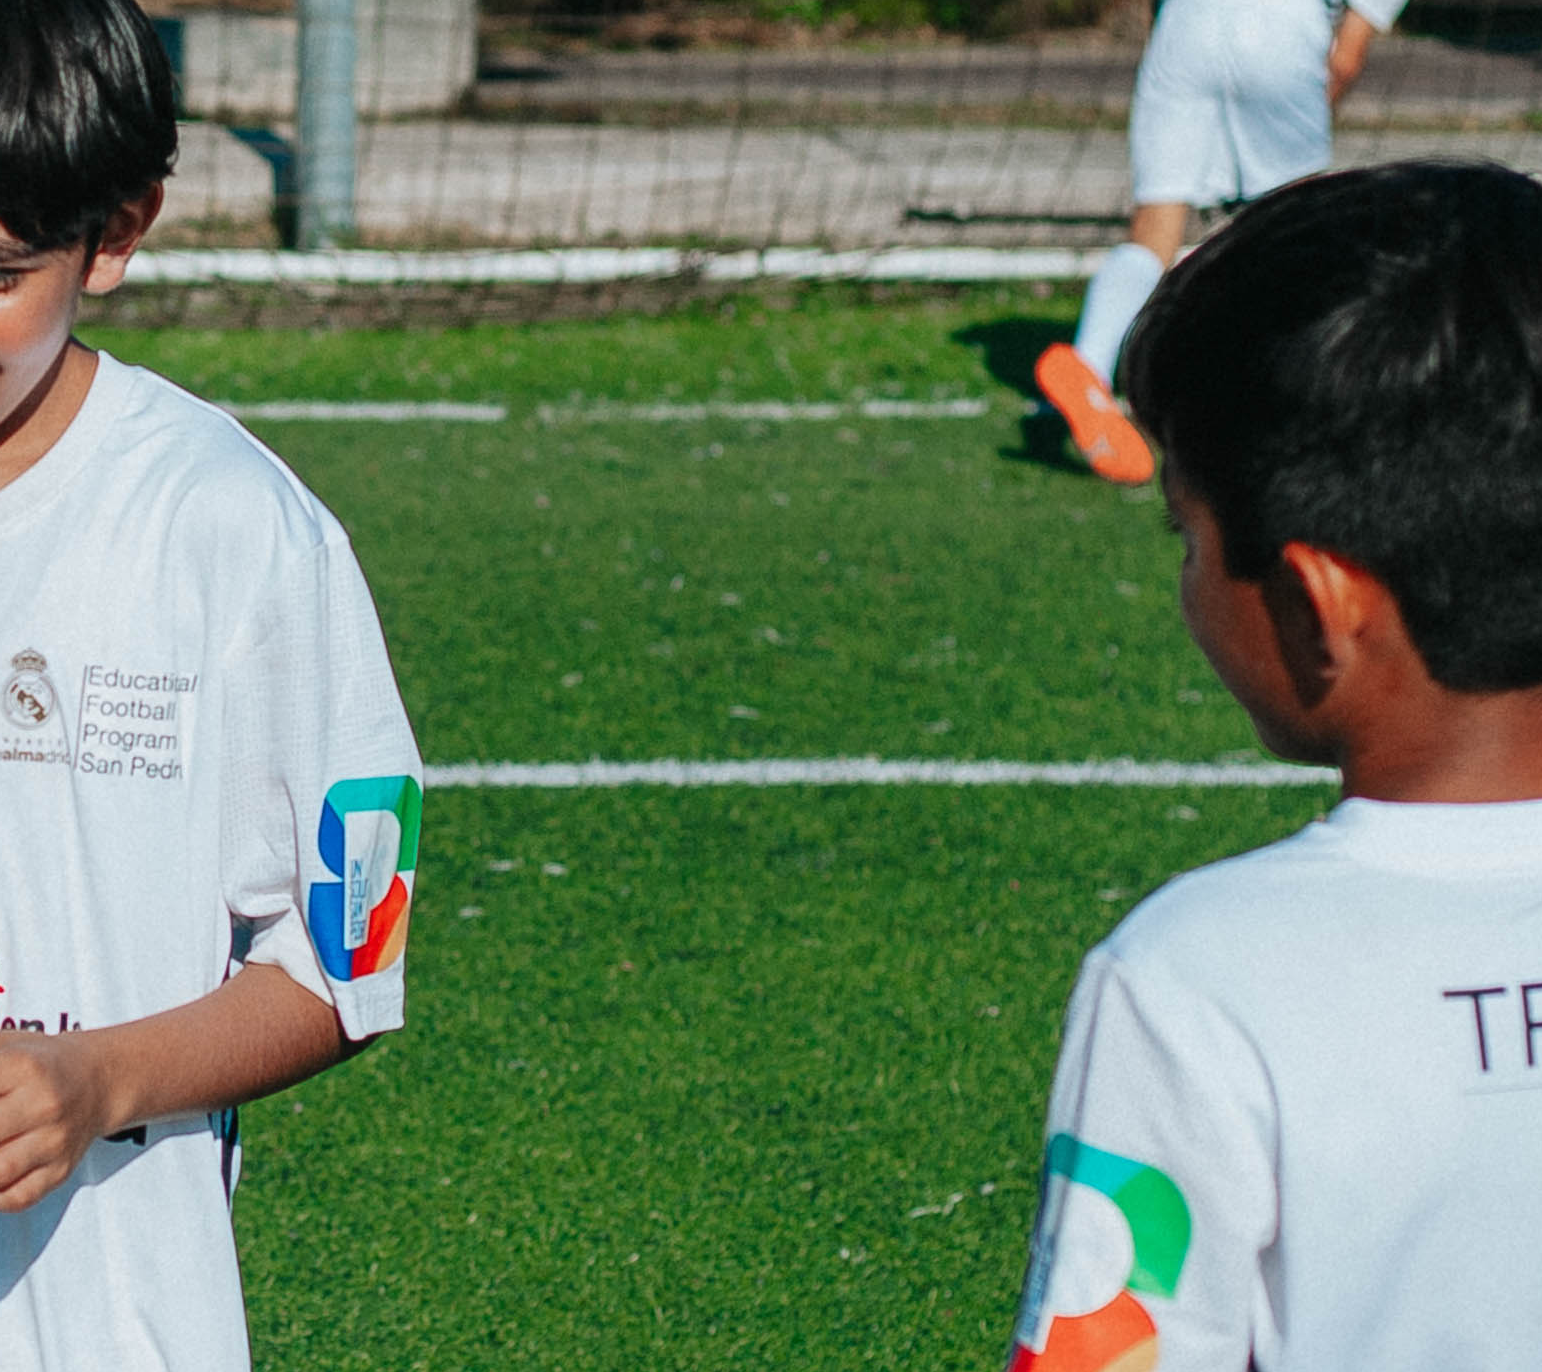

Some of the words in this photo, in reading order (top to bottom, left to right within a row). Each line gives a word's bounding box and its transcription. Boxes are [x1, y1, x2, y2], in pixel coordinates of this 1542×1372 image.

[82, 723, 178, 753] Program
[79, 752, 123, 776] San
[130, 756, 184, 780] Pedr
